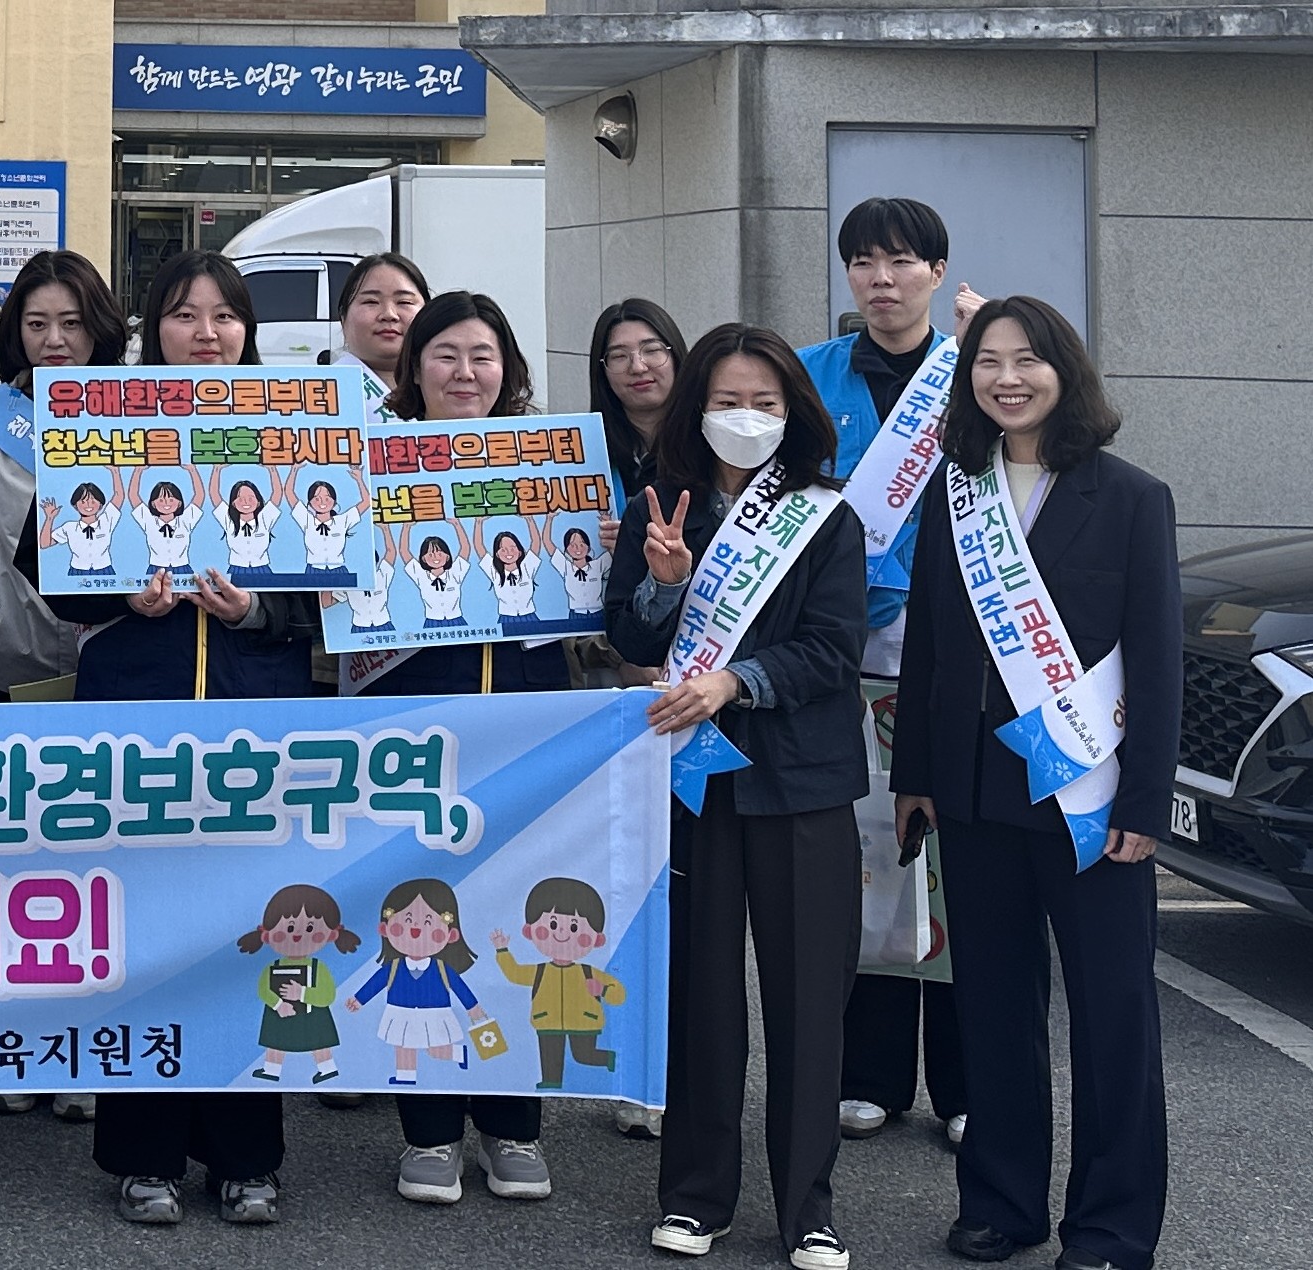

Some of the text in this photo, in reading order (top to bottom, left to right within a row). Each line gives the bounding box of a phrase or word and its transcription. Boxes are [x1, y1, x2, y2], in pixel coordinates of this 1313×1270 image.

[130, 55, 463, 97] 함께 만드는 영광 같이 누리는 군민
[48, 378, 340, 417] 유해환경으로부터
[891, 390, 935, 439] 주변
[41, 427, 365, 467] 청소년을 보호합시다
[451, 474, 611, 518] 보호합시다
[766, 493, 818, 550] 함께
[694, 542, 742, 604] 학교
[959, 529, 996, 590] 학교
[981, 501, 1031, 593] 지키는
[711, 544, 779, 633] 지키는
[977, 591, 1026, 658] 주변
